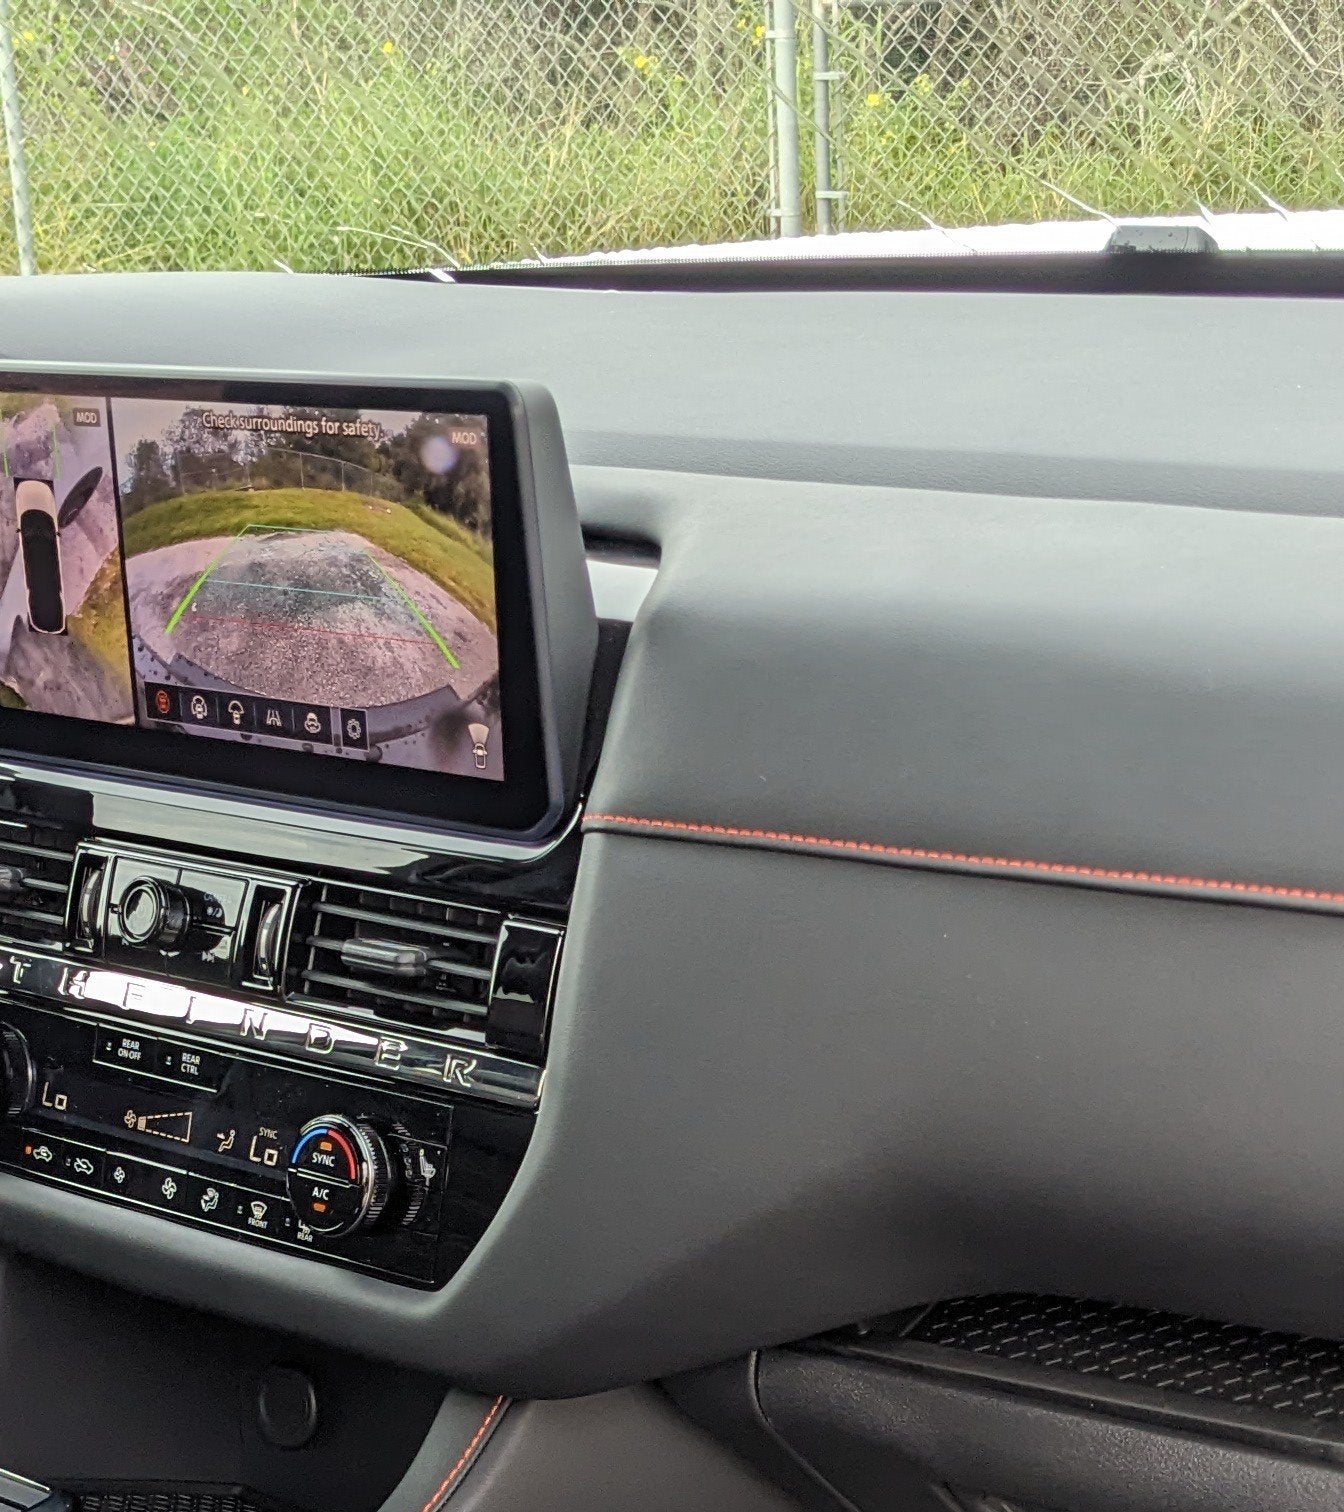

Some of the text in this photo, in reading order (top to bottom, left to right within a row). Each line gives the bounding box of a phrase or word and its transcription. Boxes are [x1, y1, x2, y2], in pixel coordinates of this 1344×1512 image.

[75, 411, 98, 425] MOD
[201, 411, 238, 430] Check
[238, 415, 320, 439] surroundings
[320, 418, 340, 435] for
[451, 430, 478, 446] MOD
[121, 1038, 141, 1051] REAR
[181, 1052, 201, 1066] REAR
[180, 1063, 199, 1076] CTRL
[258, 1126, 279, 1141] SYNC
[311, 1153, 336, 1168] SYNC
[311, 1186, 330, 1201] A/C
[247, 1217, 268, 1230] FRONT
[296, 1231, 314, 1244] REAR
